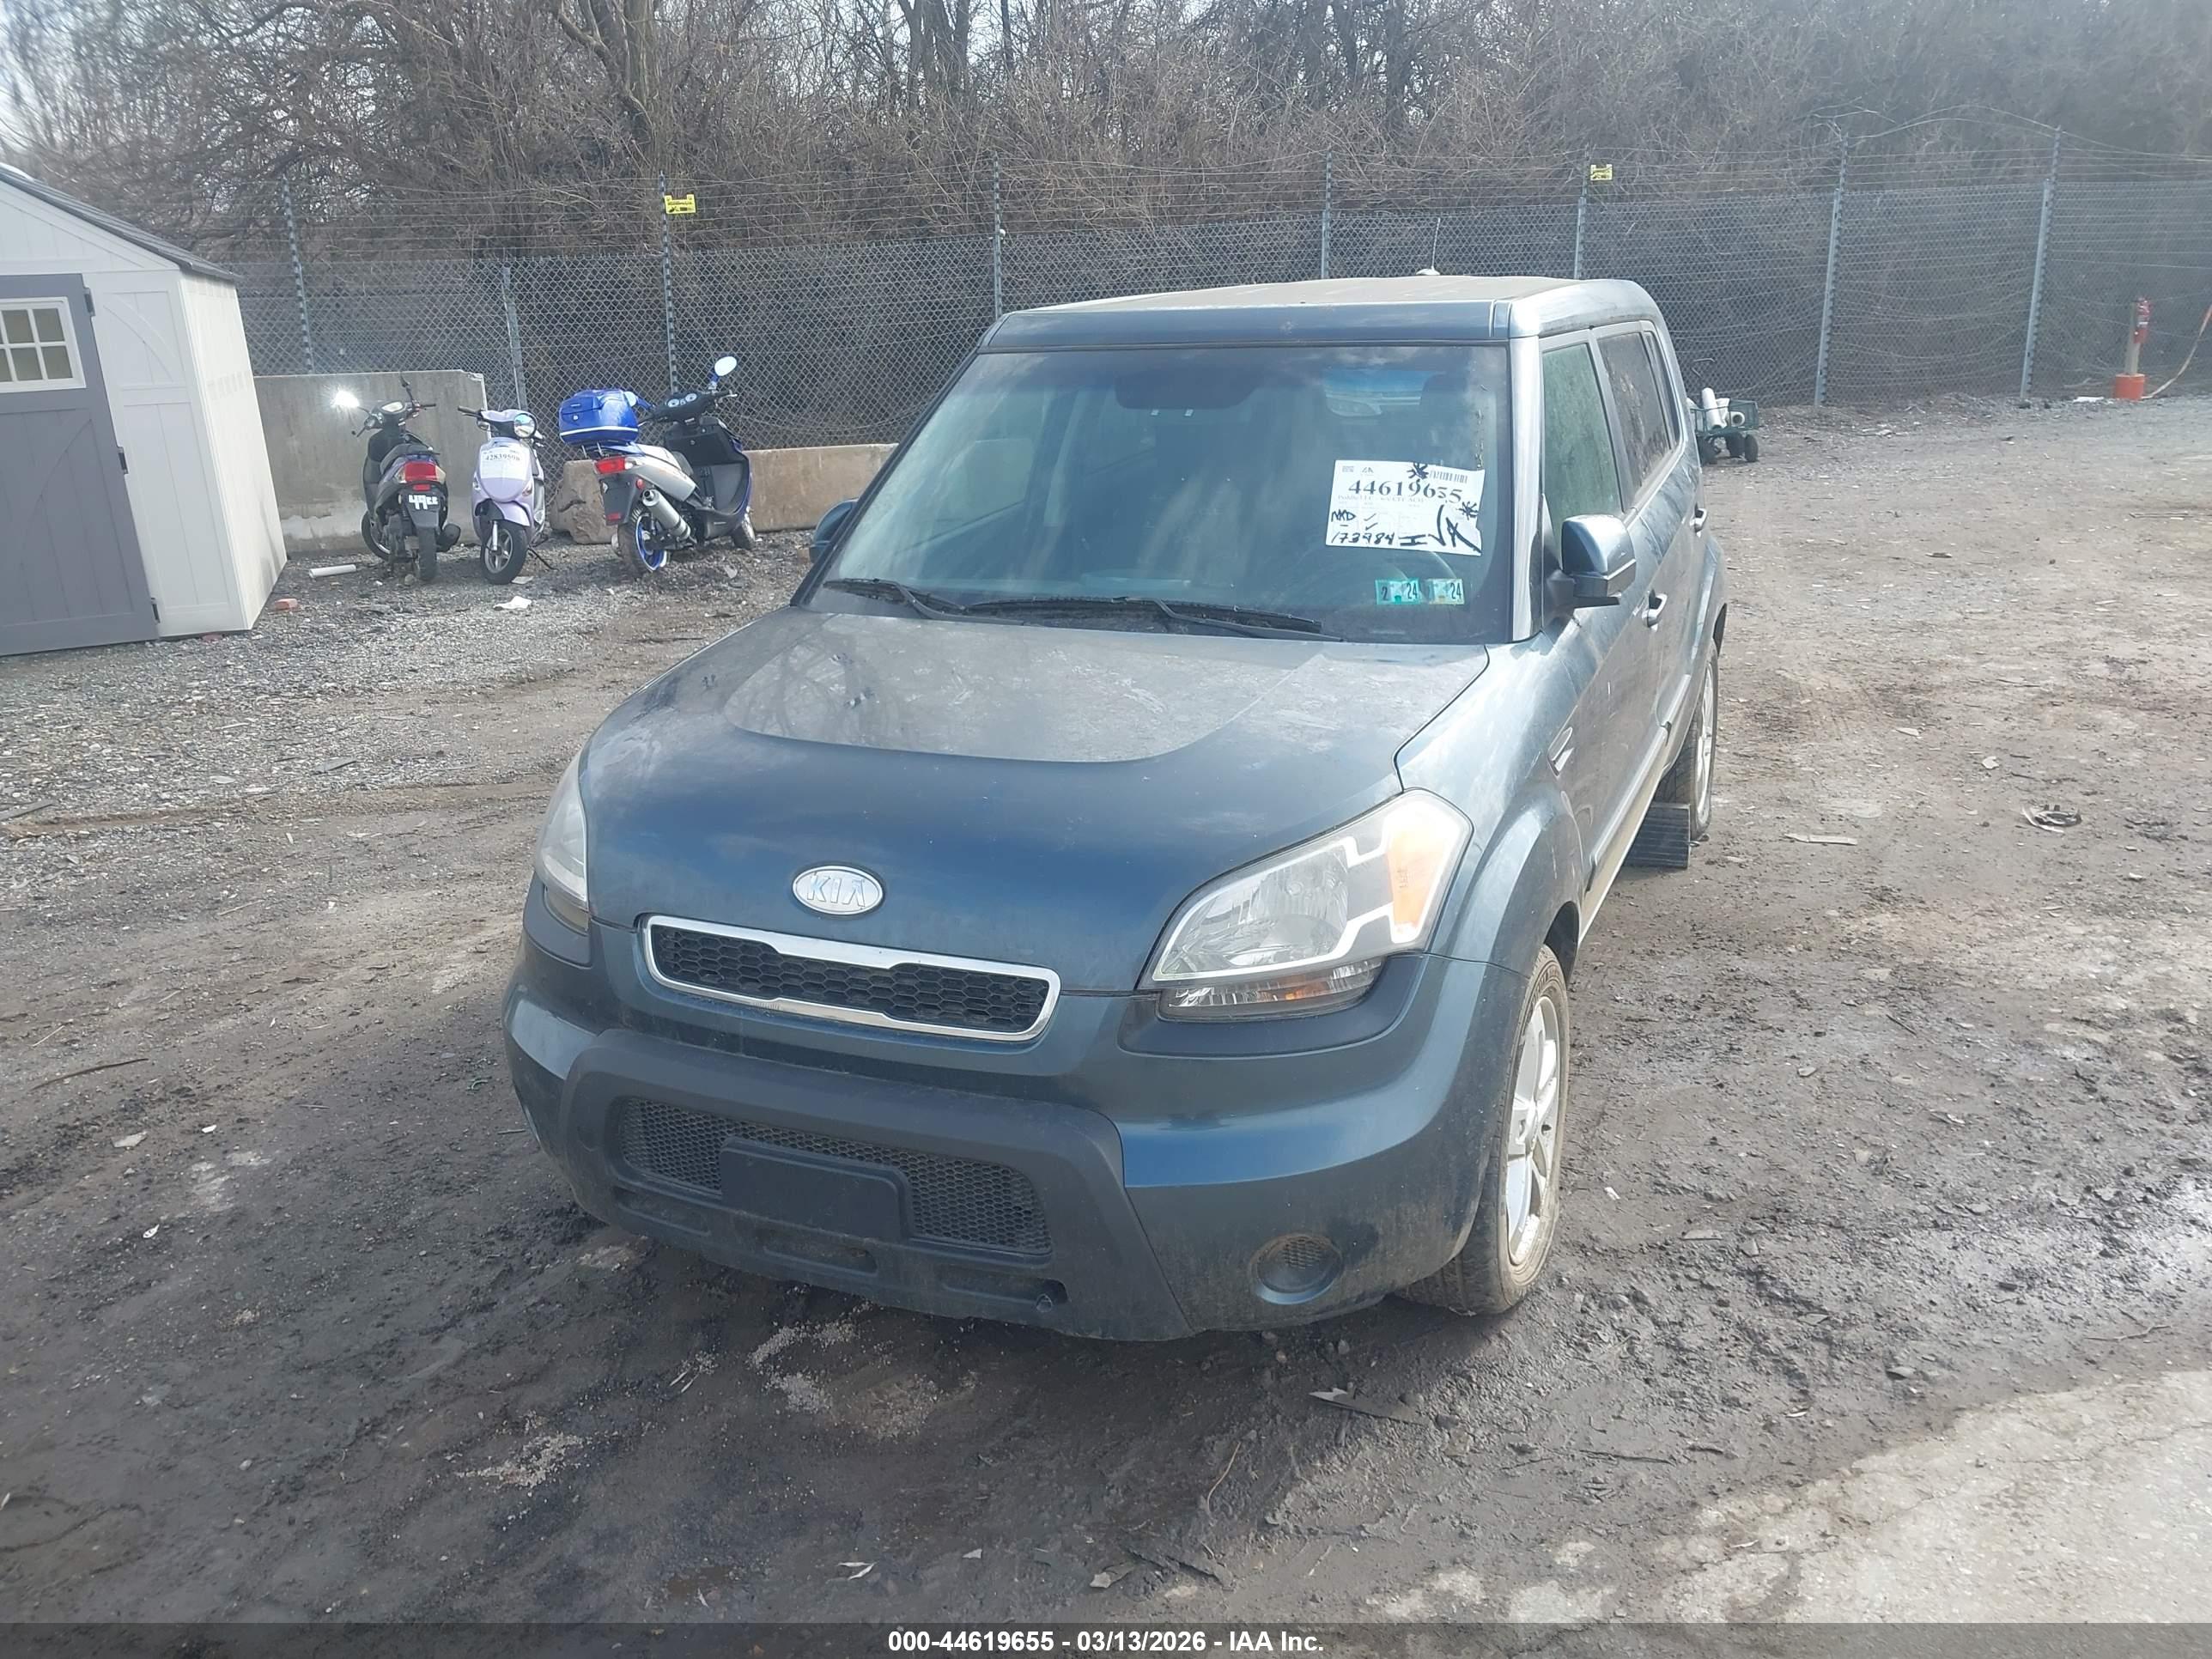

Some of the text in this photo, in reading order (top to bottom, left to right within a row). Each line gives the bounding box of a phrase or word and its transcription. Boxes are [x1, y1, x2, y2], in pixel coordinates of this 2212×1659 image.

[1348, 479, 1463, 504] 44619655
[1407, 582, 1418, 599] 24
[1450, 582, 1462, 599] 24
[806, 872, 866, 907] KIA
